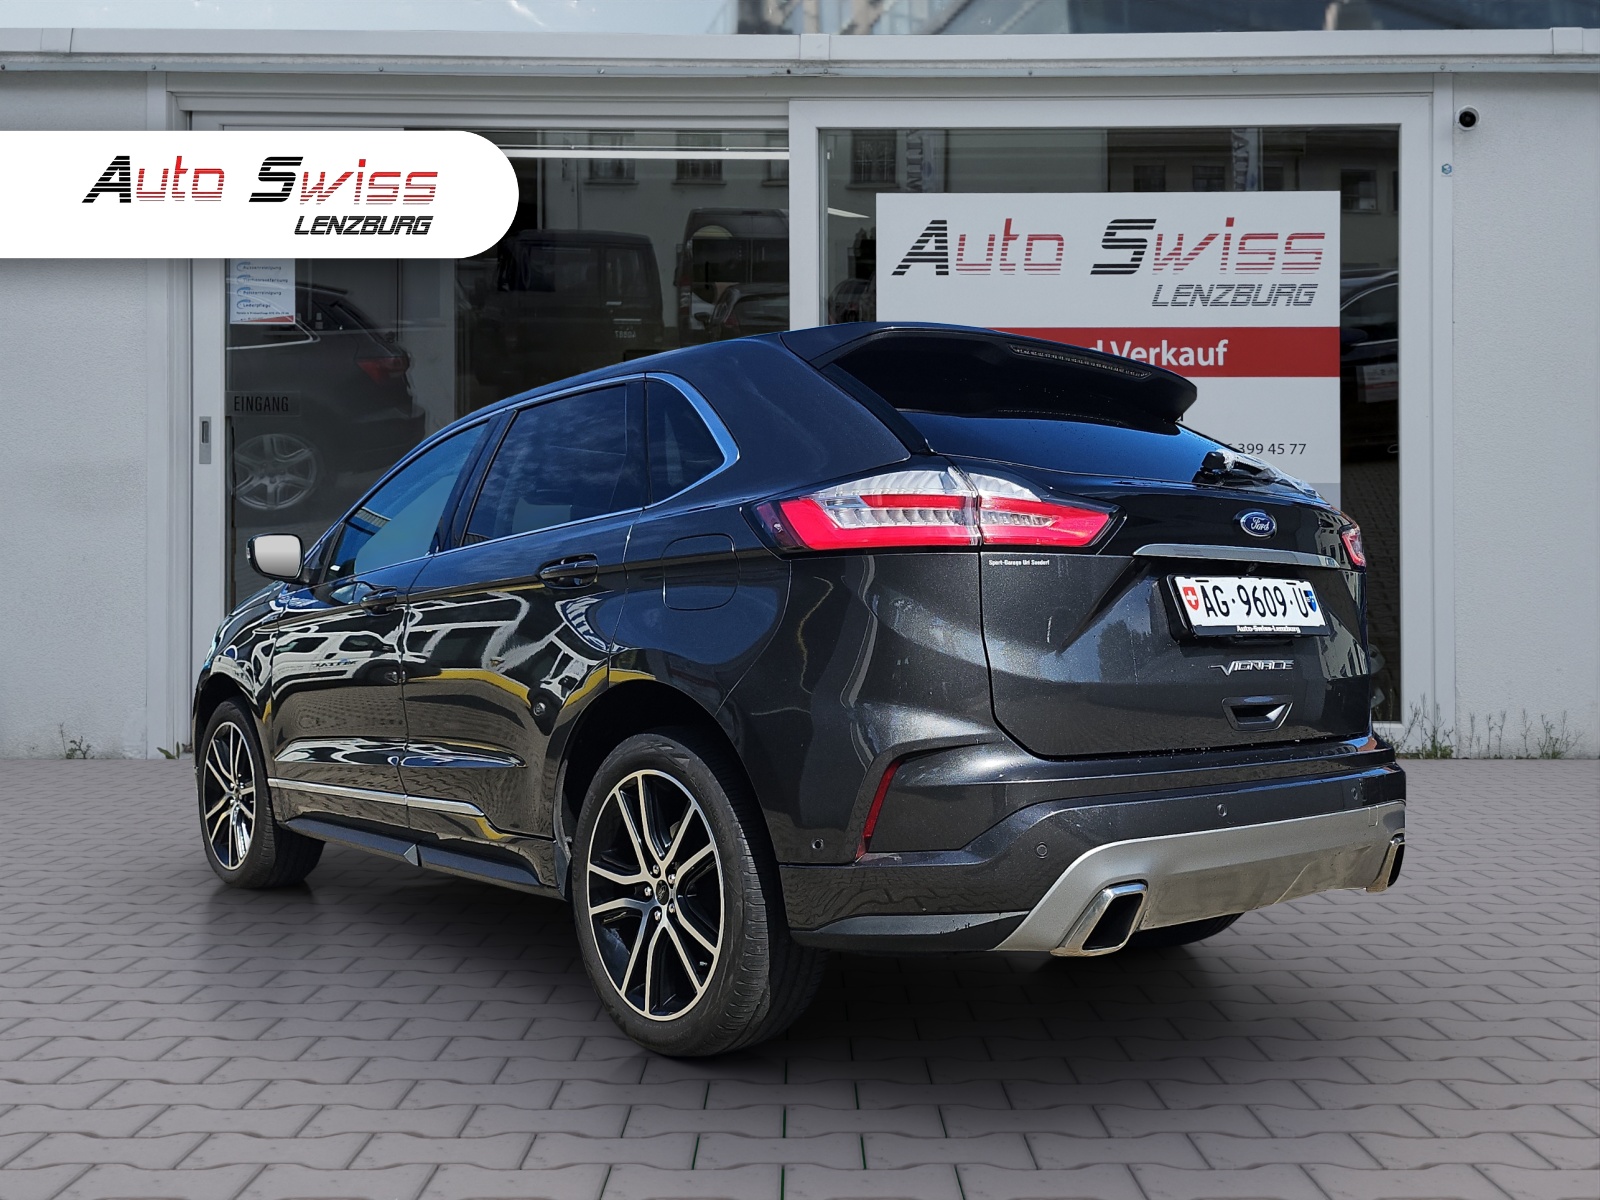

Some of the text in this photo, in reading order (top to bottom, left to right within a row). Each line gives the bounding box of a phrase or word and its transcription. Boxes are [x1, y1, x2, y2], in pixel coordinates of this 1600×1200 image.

[891, 217, 1326, 276] Auto Swiss
[1152, 283, 1319, 307] LENZBURG
[1109, 339, 1230, 366] Verkauf
[234, 395, 290, 412] EINGANG
[1239, 443, 1307, 455] 399 45 77
[1250, 516, 1270, 531] Ford
